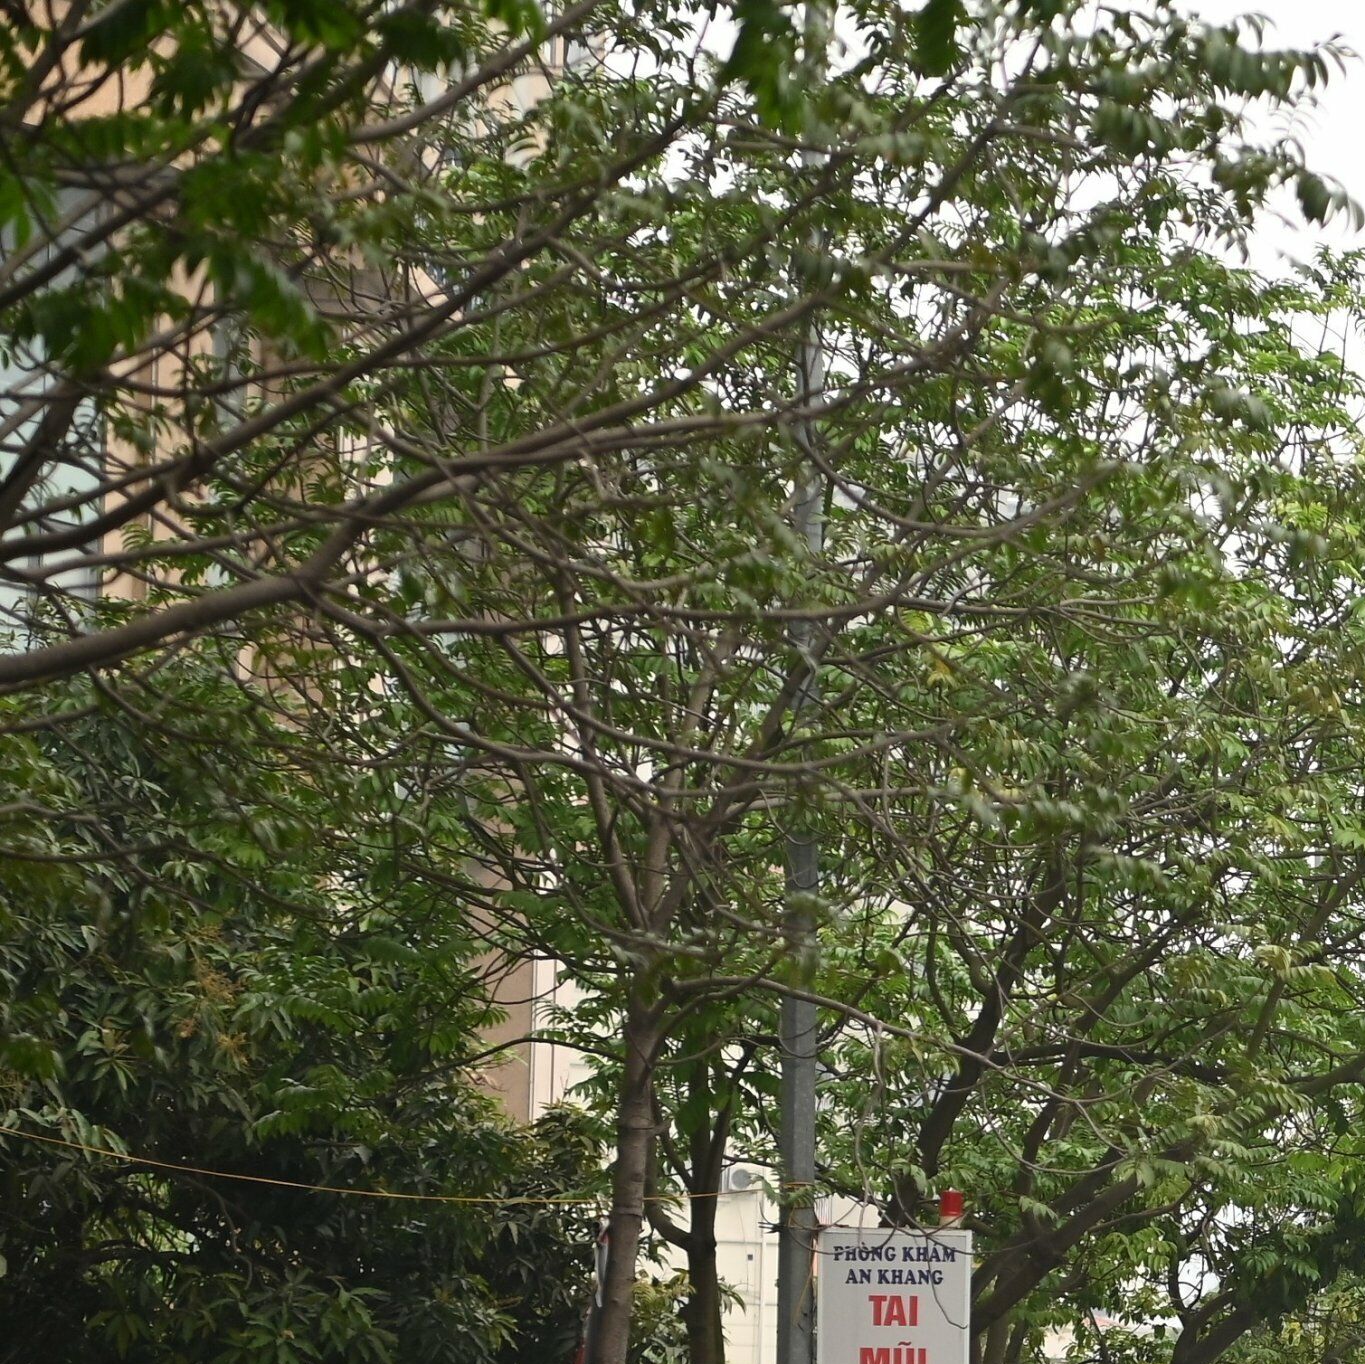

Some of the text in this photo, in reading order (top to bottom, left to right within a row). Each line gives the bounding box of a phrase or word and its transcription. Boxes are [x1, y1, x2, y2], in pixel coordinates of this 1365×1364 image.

[833, 1241, 956, 1263] PHÒNG KHÁM
[845, 1268, 944, 1286] AN KHANG
[868, 1295, 918, 1327] TAI
